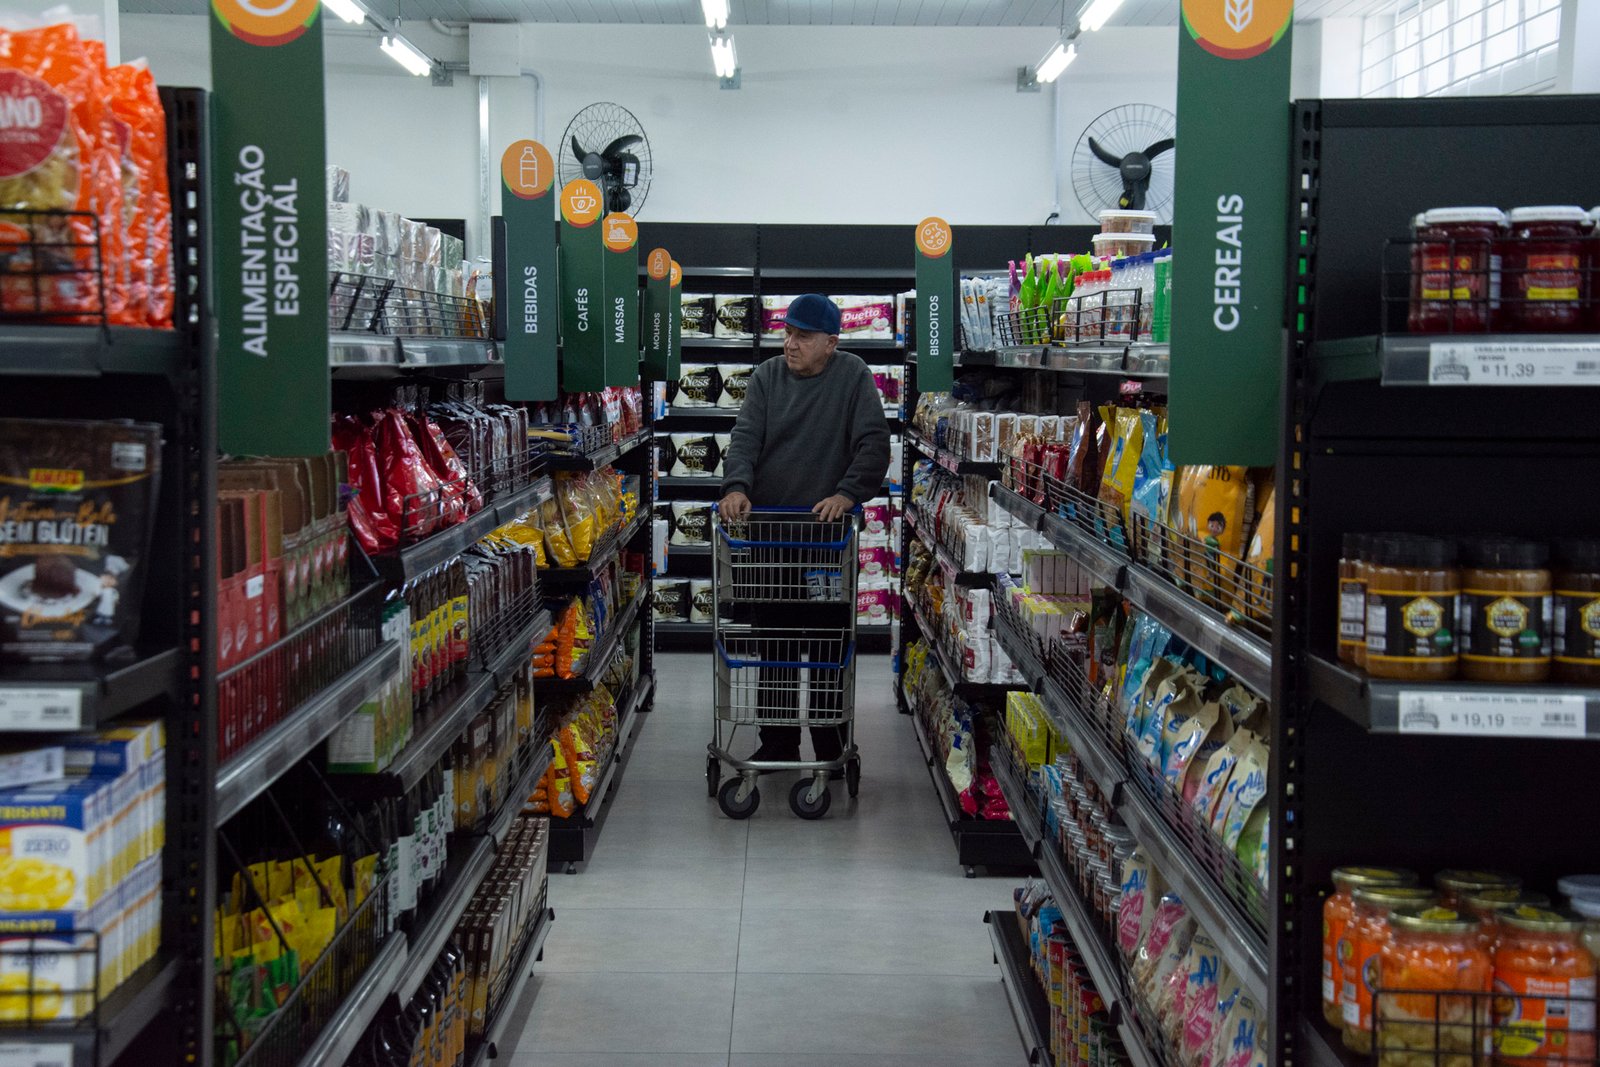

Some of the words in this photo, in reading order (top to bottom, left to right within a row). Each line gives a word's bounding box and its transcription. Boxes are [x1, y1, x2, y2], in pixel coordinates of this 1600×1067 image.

[235, 144, 271, 357] ALIMENTAÇÃO
[274, 178, 299, 316] ESPECIAL
[1213, 194, 1244, 332] CEREAIS
[523, 265, 539, 335] BEBIDAS
[575, 287, 589, 331] CAFÉS
[614, 297, 626, 344] MASSAS
[720, 306, 746, 317] Ness
[843, 308, 880, 321] Duetto
[653, 312, 661, 351] MOLHOS
[928, 295, 941, 357] BISCOITOS
[683, 375, 709, 386] Ness
[728, 375, 749, 386] Nes
[1494, 362, 1534, 378] 11,39
[681, 445, 708, 457] Ness
[37, 517, 109, 546] GLÚTEN
[654, 591, 680, 602] Ness
[1463, 713, 1504, 729] 19,19
[23, 838, 71, 854] ZERO
